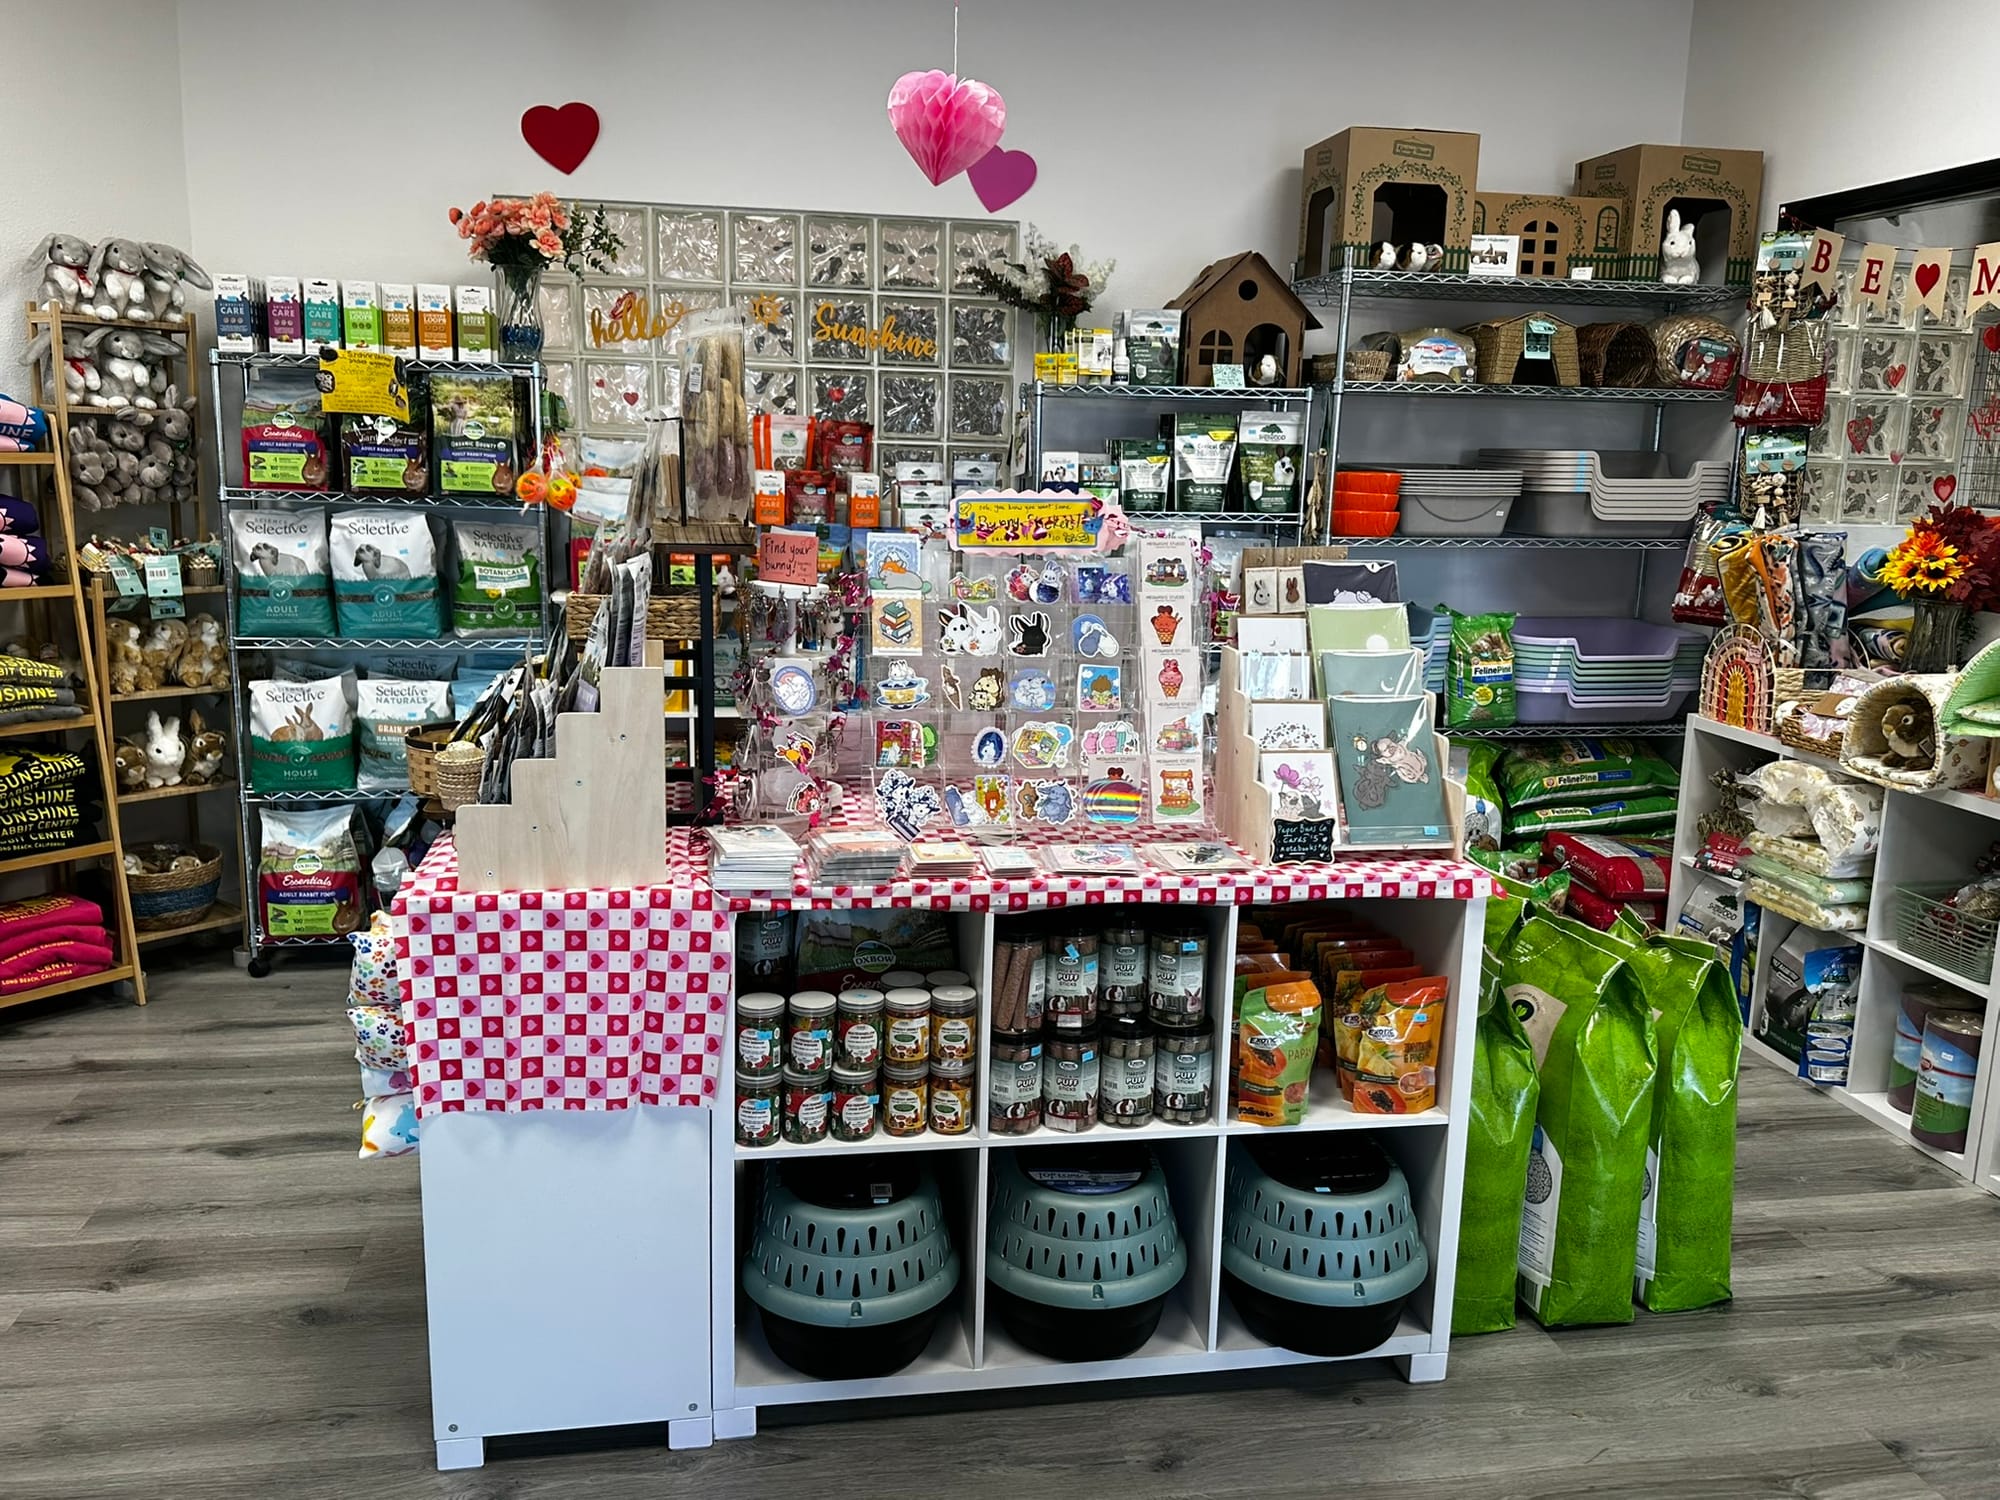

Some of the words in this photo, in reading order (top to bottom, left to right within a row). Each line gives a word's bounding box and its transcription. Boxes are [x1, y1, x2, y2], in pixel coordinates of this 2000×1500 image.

[220, 307, 244, 315] CARE
[271, 309, 295, 317] CARE
[308, 310, 332, 318] CARE
[591, 296, 668, 349] hello
[814, 302, 938, 358] Sunshine
[263, 427, 302, 438] Essentials
[245, 521, 308, 535] Selective
[349, 521, 409, 535] Selective
[473, 530, 523, 543] Selective
[474, 541, 523, 550] NATURALS
[765, 537, 786, 554] Find
[789, 545, 812, 563] your
[478, 567, 525, 576] BOTANICALS
[765, 558, 797, 577] bunny!
[266, 605, 298, 613] ADULT
[372, 610, 403, 618] ADULT
[388, 658, 437, 671] Selective
[20, 667, 63, 678] CENTER
[376, 685, 428, 697] Selective
[266, 690, 325, 703] Selective
[376, 696, 428, 704] NATURALS
[0, 755, 84, 793] SUNSHINE
[0, 781, 40, 800] RABBIT
[43, 767, 86, 785] CENTER
[1558, 775, 1598, 785] FelinePine
[37, 818, 79, 830] CENTER
[29, 830, 74, 841] CENTER
[282, 875, 332, 887] Essentials
[855, 955, 894, 965] OXBOW
[1114, 964, 1136, 973] PUFF
[2, 978, 18, 986] LONG
[40, 969, 73, 980] CALIFORNIA
[1057, 972, 1080, 982] PUFF
[1156, 971, 1177, 982] PUFF
[1368, 1027, 1394, 1036] EXOTIC
[1250, 1036, 1277, 1044] EXOTIC
[1174, 1071, 1197, 1081] PUFF
[1017, 1078, 1036, 1088] PUFF
[1056, 1077, 1079, 1087] PUFF
[1125, 1077, 1147, 1086] PUFF
